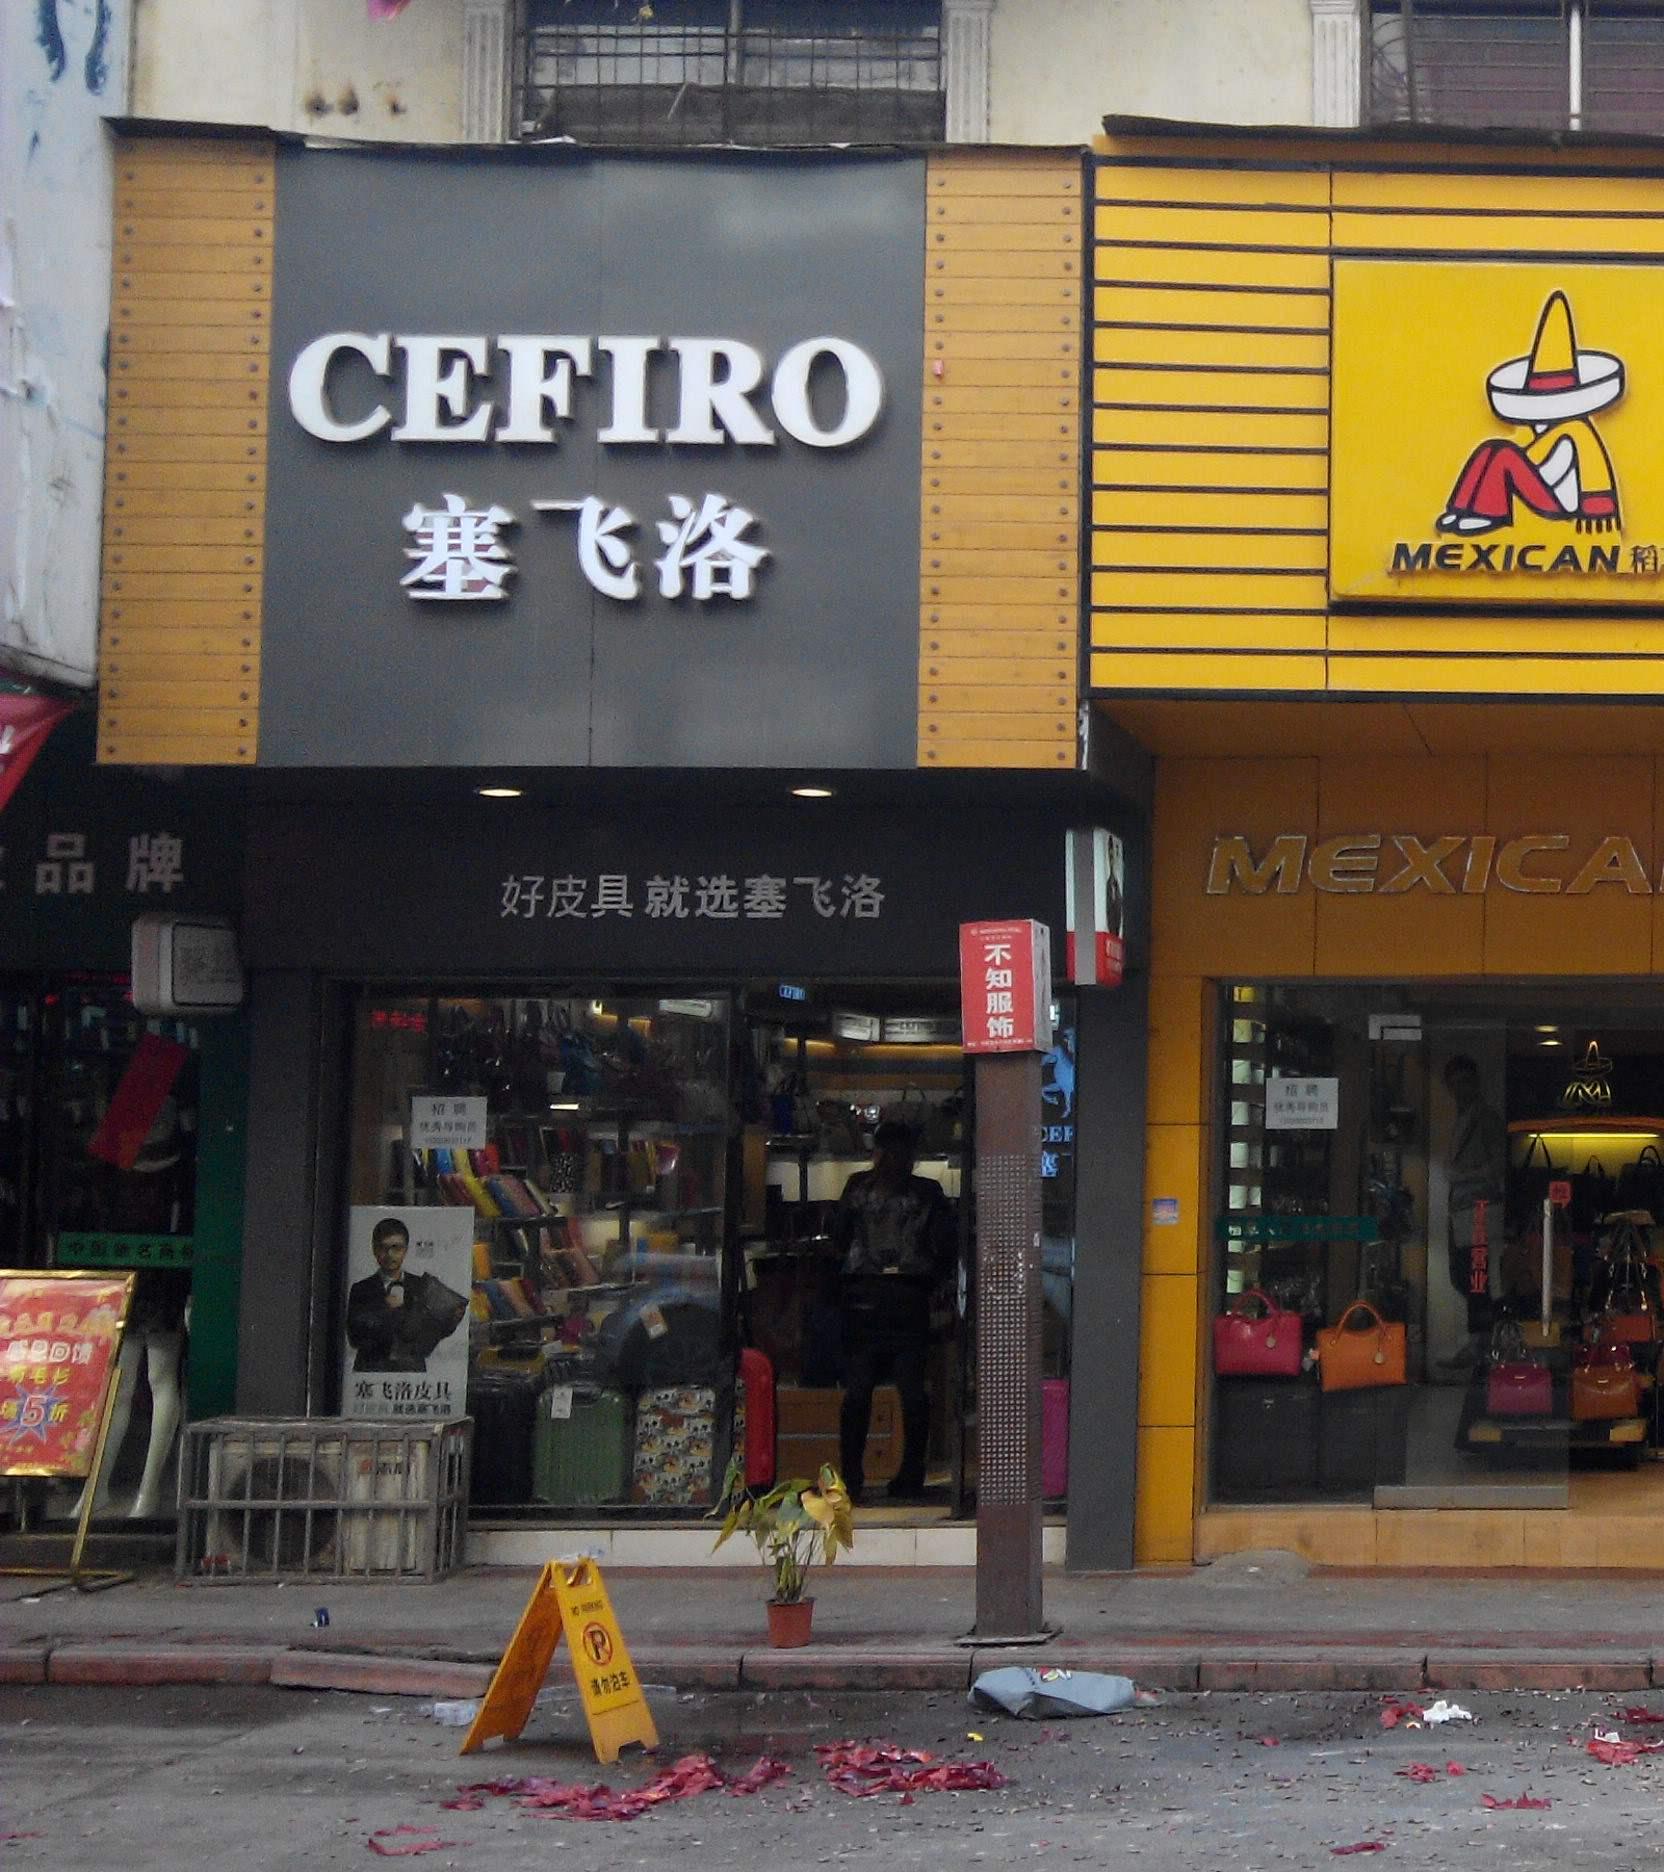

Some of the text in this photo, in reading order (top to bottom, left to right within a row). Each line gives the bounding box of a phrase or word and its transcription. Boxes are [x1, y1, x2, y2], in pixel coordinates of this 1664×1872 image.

[289, 333, 883, 448] CEFIRO
[400, 493, 769, 601] 塞飞洛
[1392, 543, 1620, 572] MEXICAN
[0, 832, 184, 894] 品牌
[983, 943, 1015, 1038] 不知服饰
[354, 1380, 452, 1401] 塞飞洛皮具
